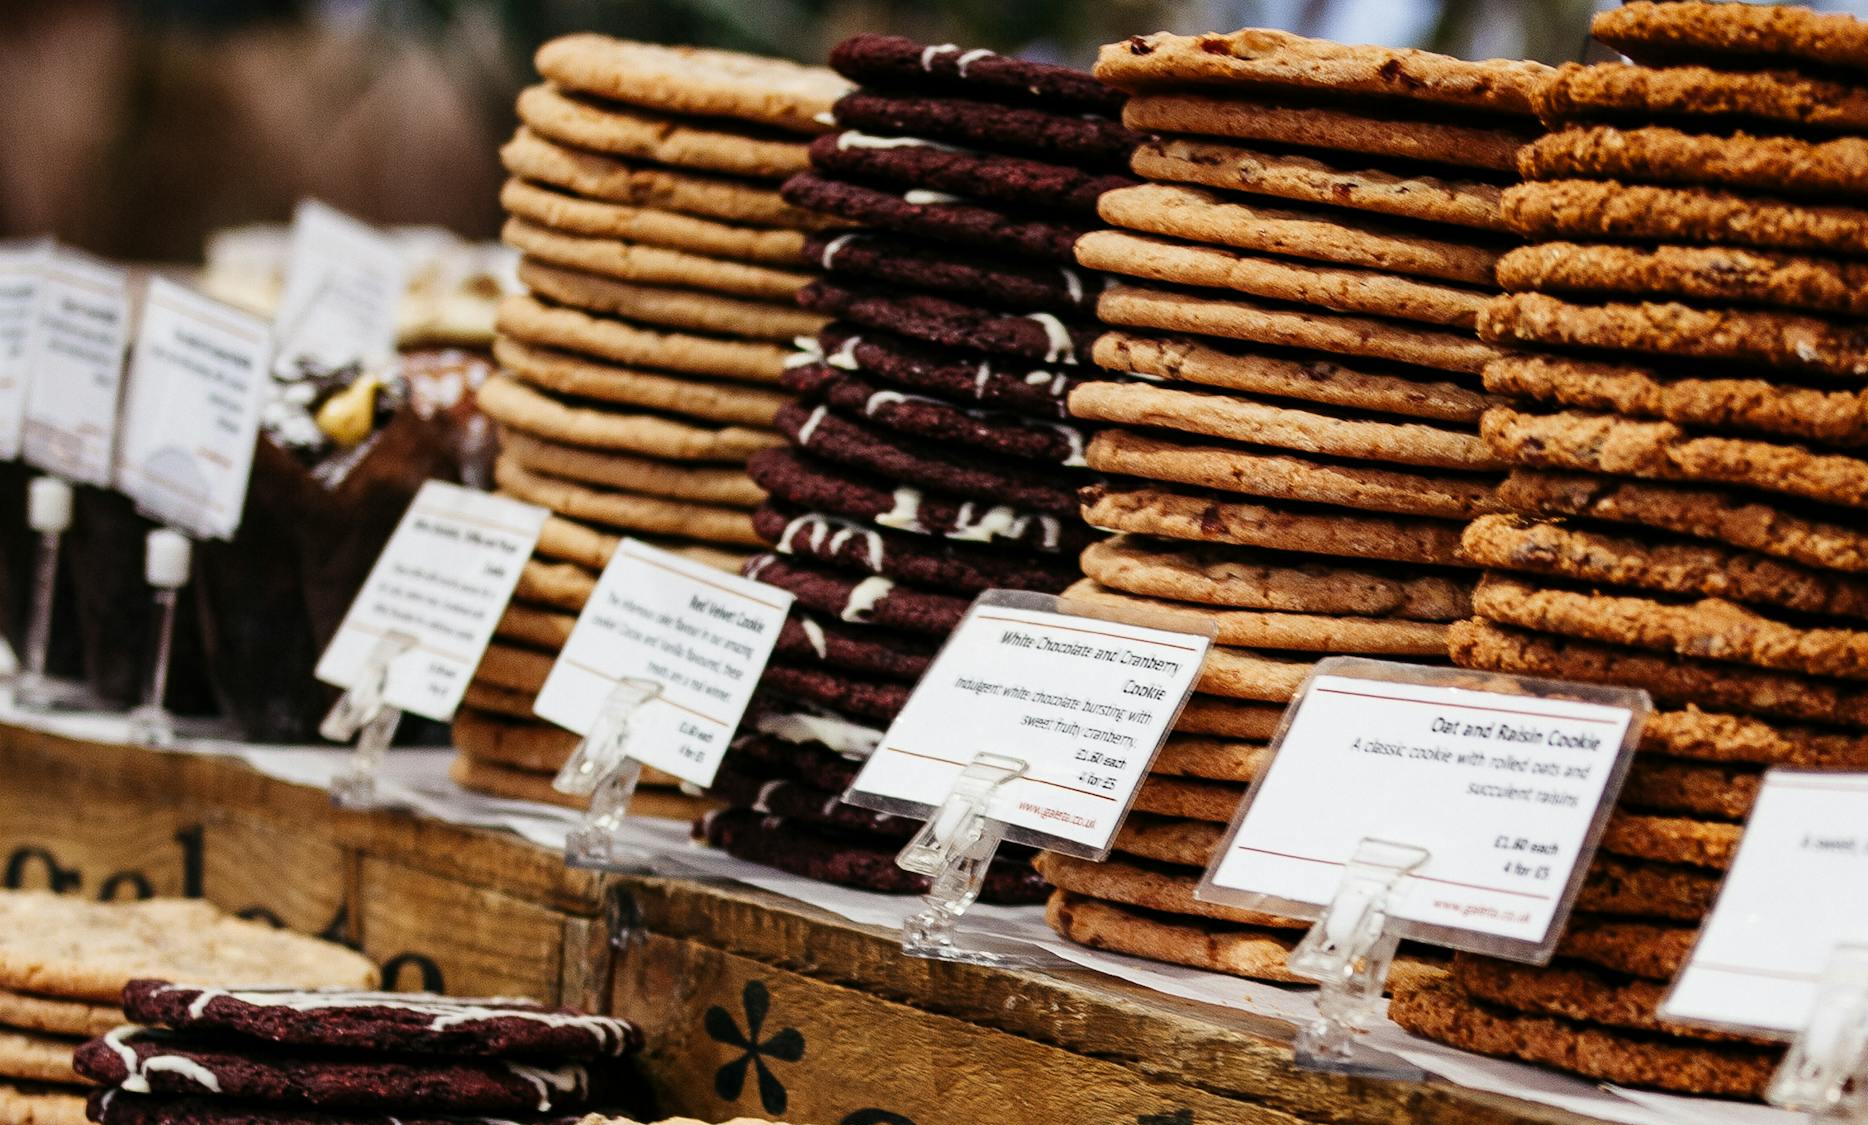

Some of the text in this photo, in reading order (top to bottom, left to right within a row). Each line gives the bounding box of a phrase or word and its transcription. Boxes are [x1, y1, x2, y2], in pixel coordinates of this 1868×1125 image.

[689, 594, 766, 635] Red Velvet Cookie
[1000, 630, 1184, 679] White Chocolate and Cranberry
[955, 677, 1153, 726] Indulgent white chocolate bursting with
[1122, 679, 1168, 701] Cookie
[1020, 714, 1055, 730] sweet
[1055, 718, 1083, 739] fruity
[1431, 717, 1602, 752] Oat and Raisin Cookie
[1102, 756, 1127, 770] each
[1353, 737, 1592, 781] A classic cookie with rolled oats and
[1466, 780, 1580, 808] succulent raisins
[1530, 841, 1560, 857] each
[1514, 862, 1532, 877] for
